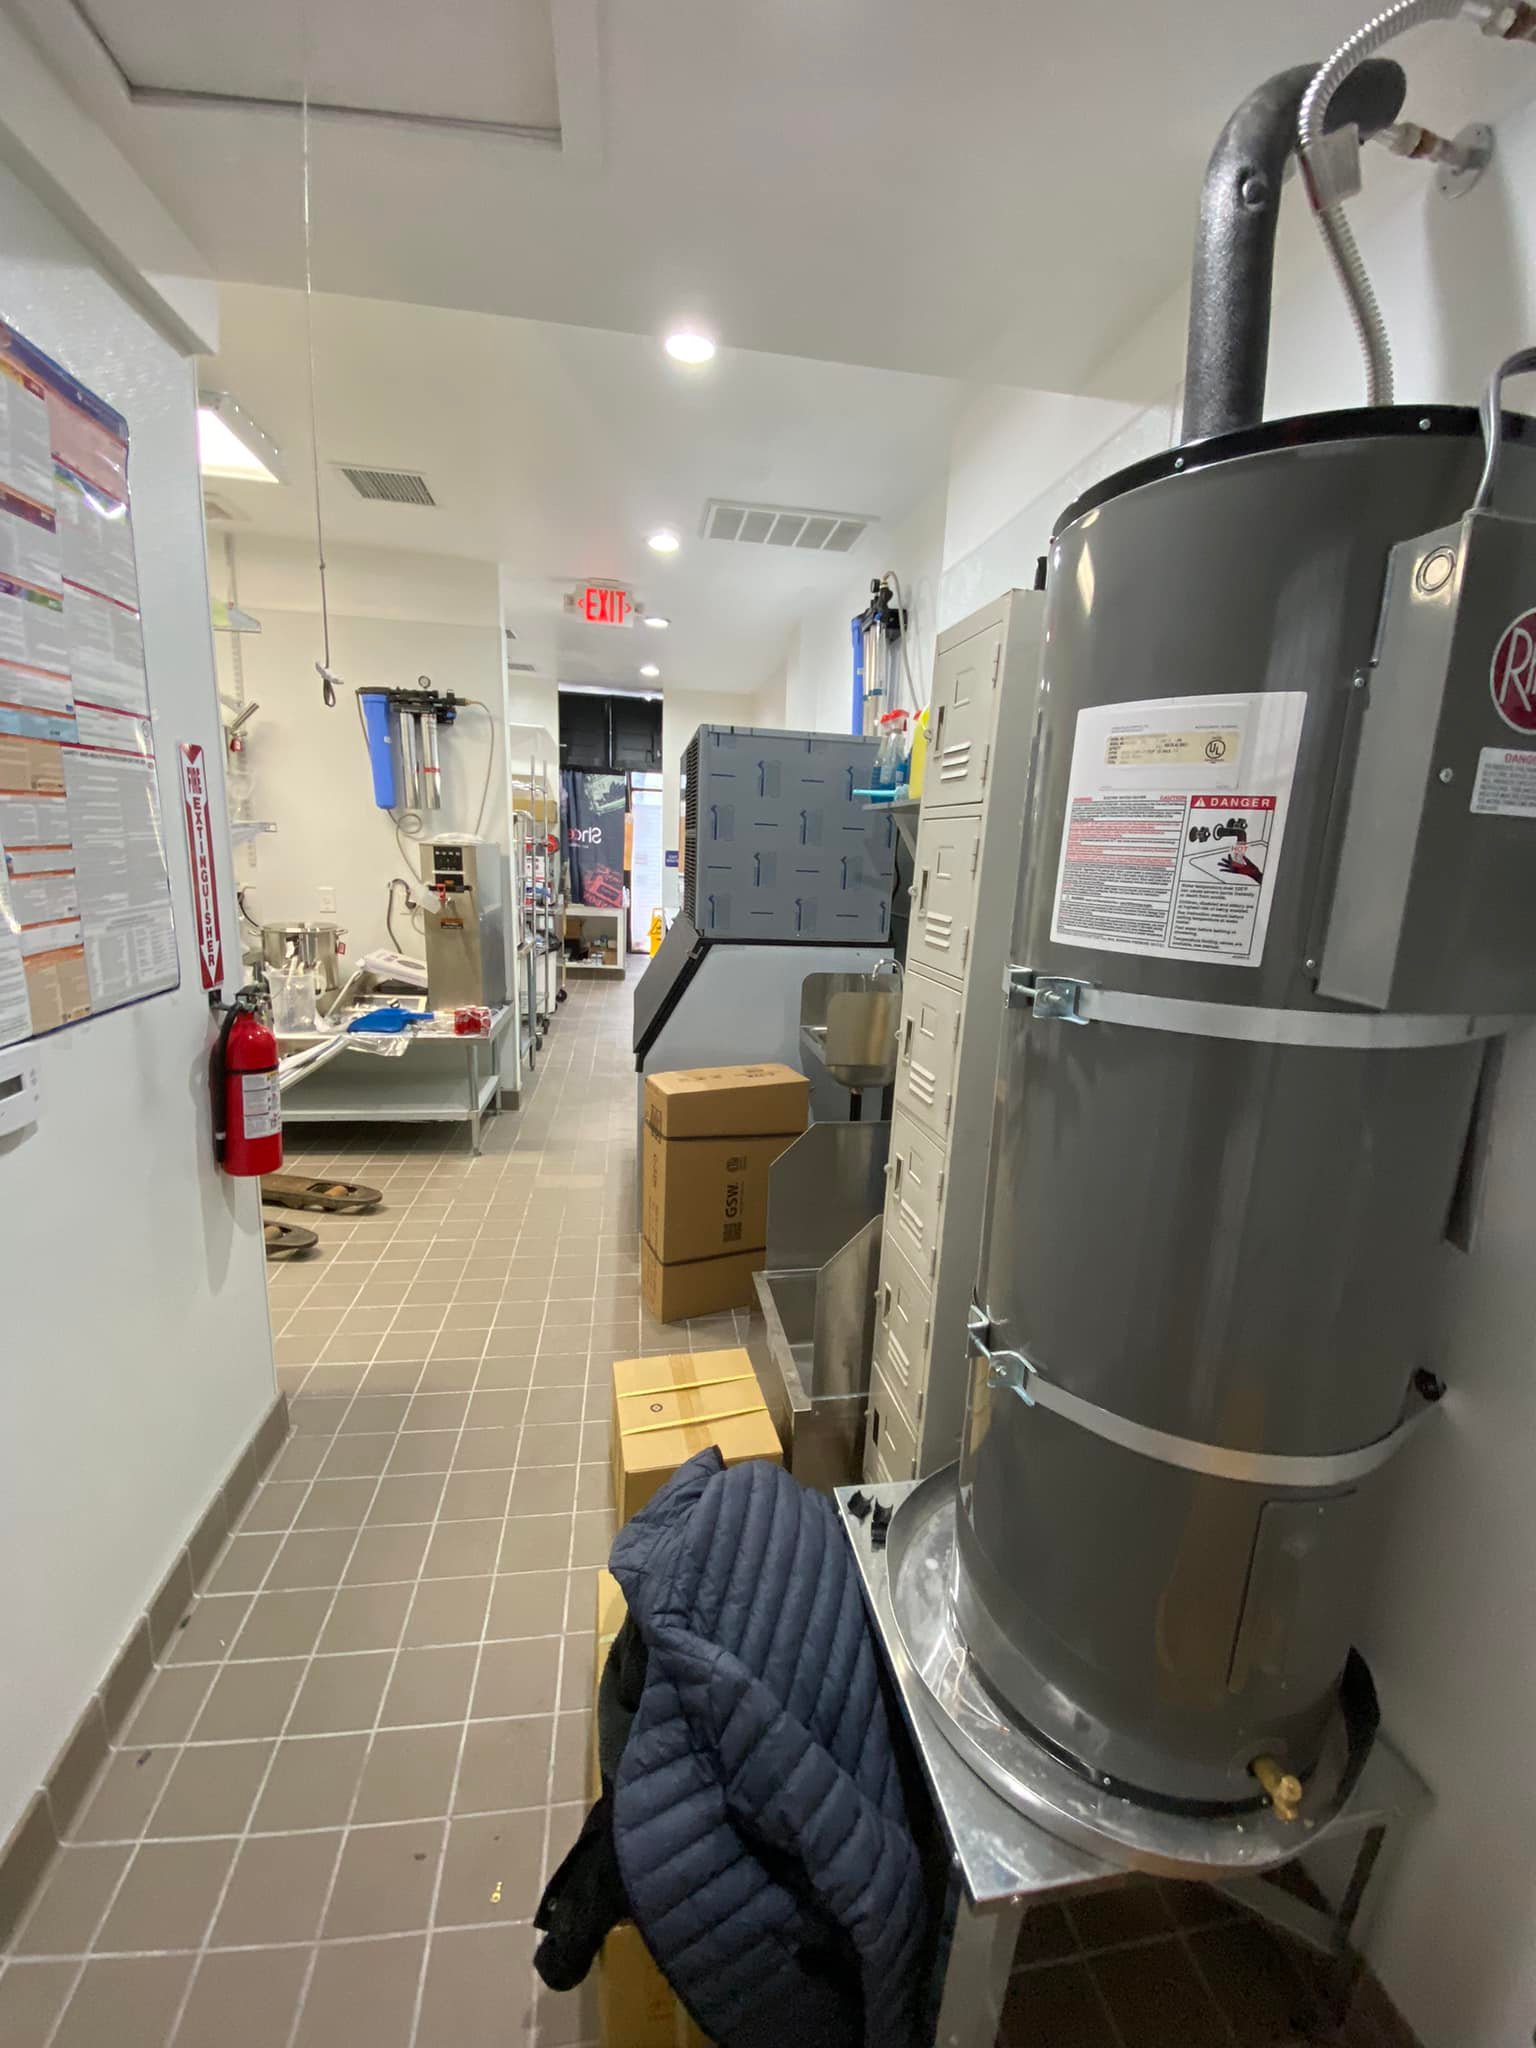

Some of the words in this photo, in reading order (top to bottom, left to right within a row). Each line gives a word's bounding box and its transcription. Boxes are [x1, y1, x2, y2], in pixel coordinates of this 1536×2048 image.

[585, 587, 626, 624] EXIT
[1210, 797, 1270, 807] DANGER
[193, 797, 216, 967] EXTINGUISHER
